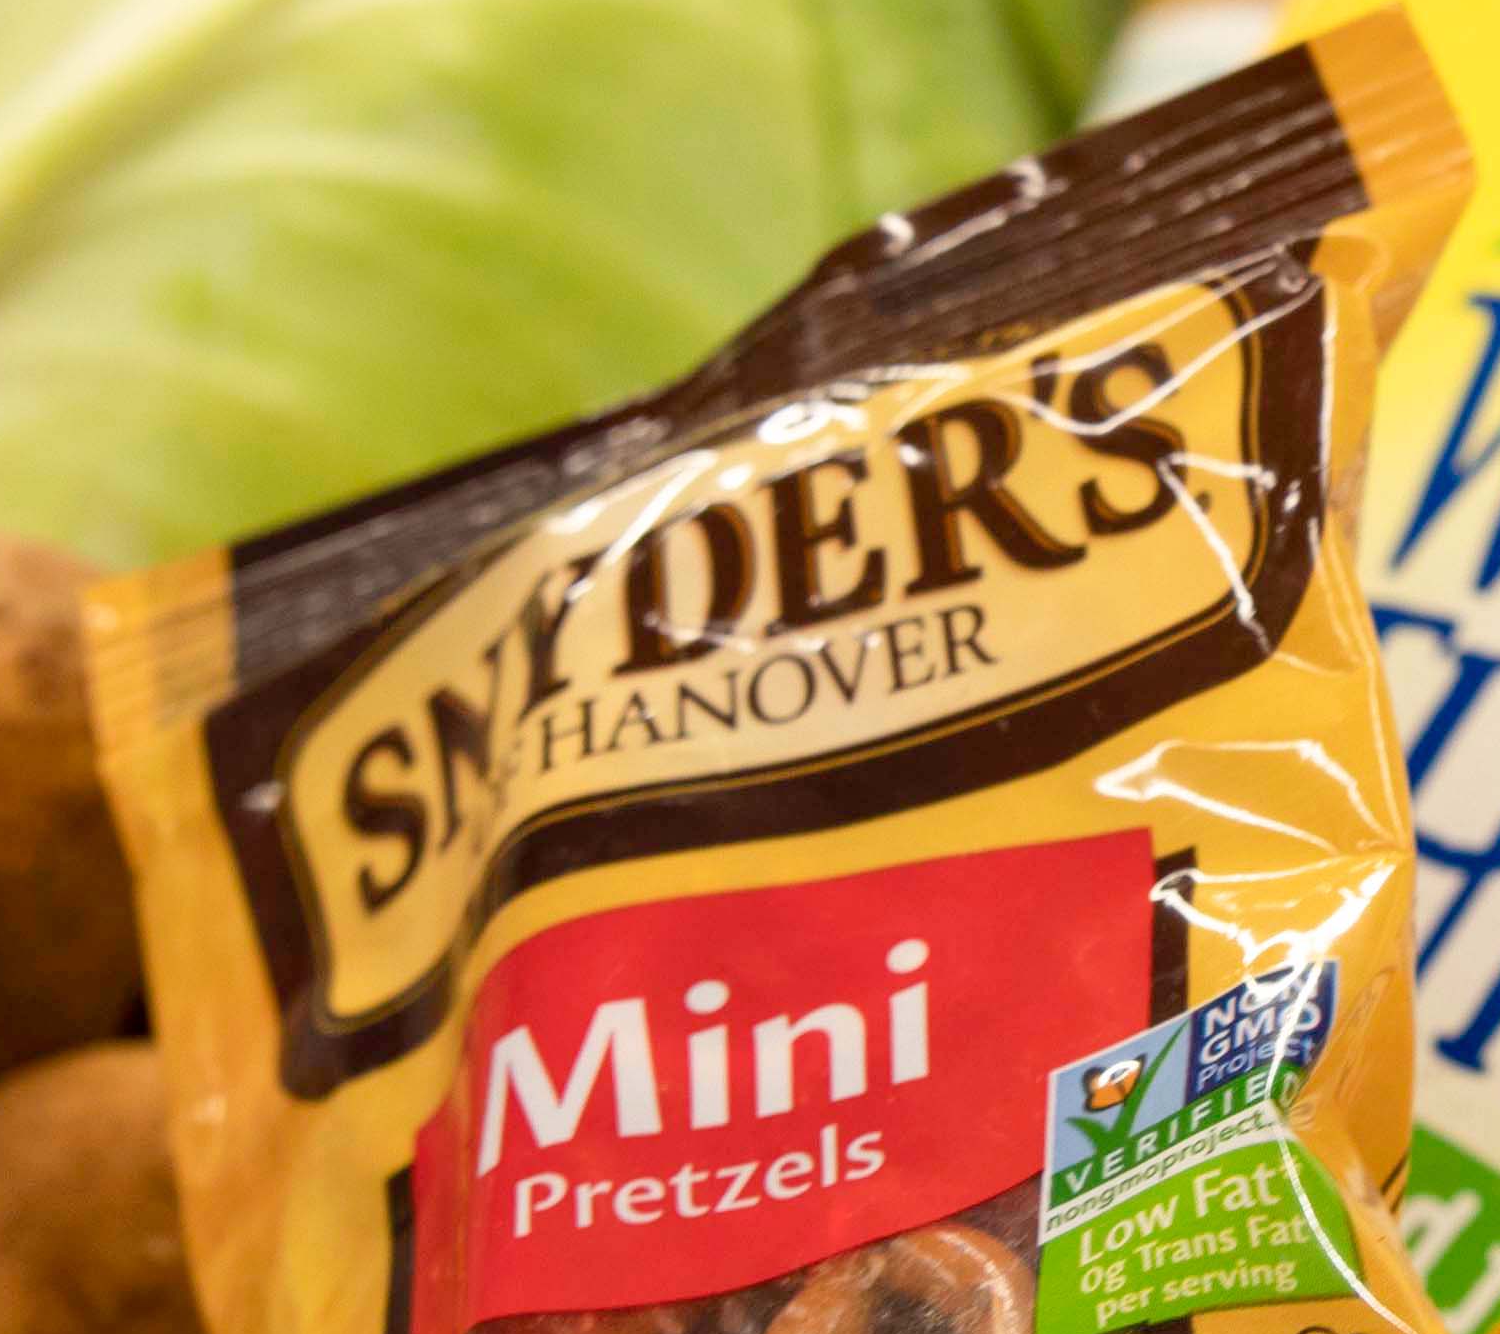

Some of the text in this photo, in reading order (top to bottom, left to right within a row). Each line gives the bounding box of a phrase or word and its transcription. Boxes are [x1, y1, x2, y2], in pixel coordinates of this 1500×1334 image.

[344, 343, 1190, 914] SNYDER'S
[540, 604, 998, 772] HANOVER
[476, 938, 930, 1178] Mini
[1196, 1036, 1316, 1092] Project
[1201, 1001, 1322, 1064] GMO
[514, 1123, 885, 1238] Pretzels
[1079, 1195, 1179, 1267] Low
[1132, 1227, 1238, 1272] Trans
[1245, 1214, 1310, 1248] Fat
[1096, 1258, 1299, 1329] per serving
